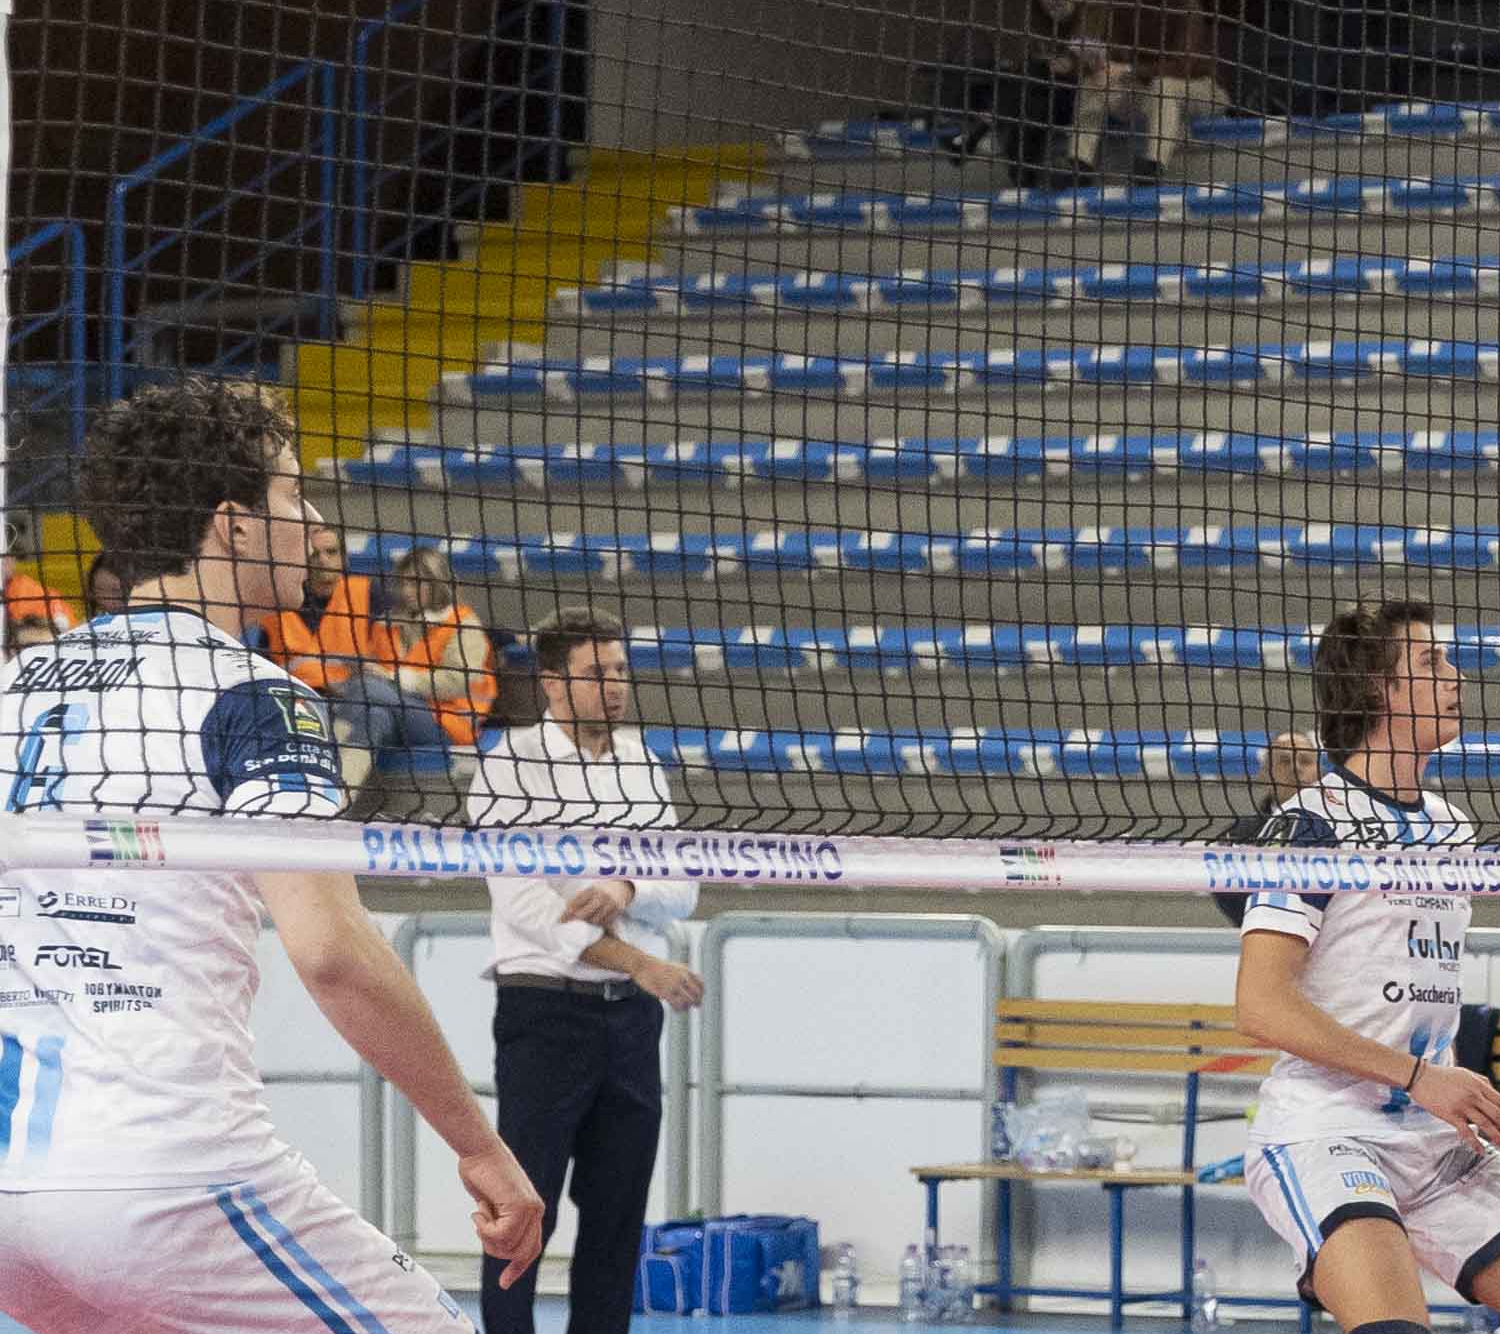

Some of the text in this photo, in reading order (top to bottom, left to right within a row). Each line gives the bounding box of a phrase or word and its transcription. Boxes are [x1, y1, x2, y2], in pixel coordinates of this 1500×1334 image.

[361, 826, 843, 880] PALLAVOLO SAN GIUSTINO
[1205, 851, 1371, 891] PALLAVOLO
[1373, 856, 1433, 891] SAN
[1414, 896, 1455, 912] COMPANY
[34, 945, 122, 970] FOREL
[1408, 982, 1455, 1004] Saccheria
[92, 1000, 141, 1014] SPIRITS
